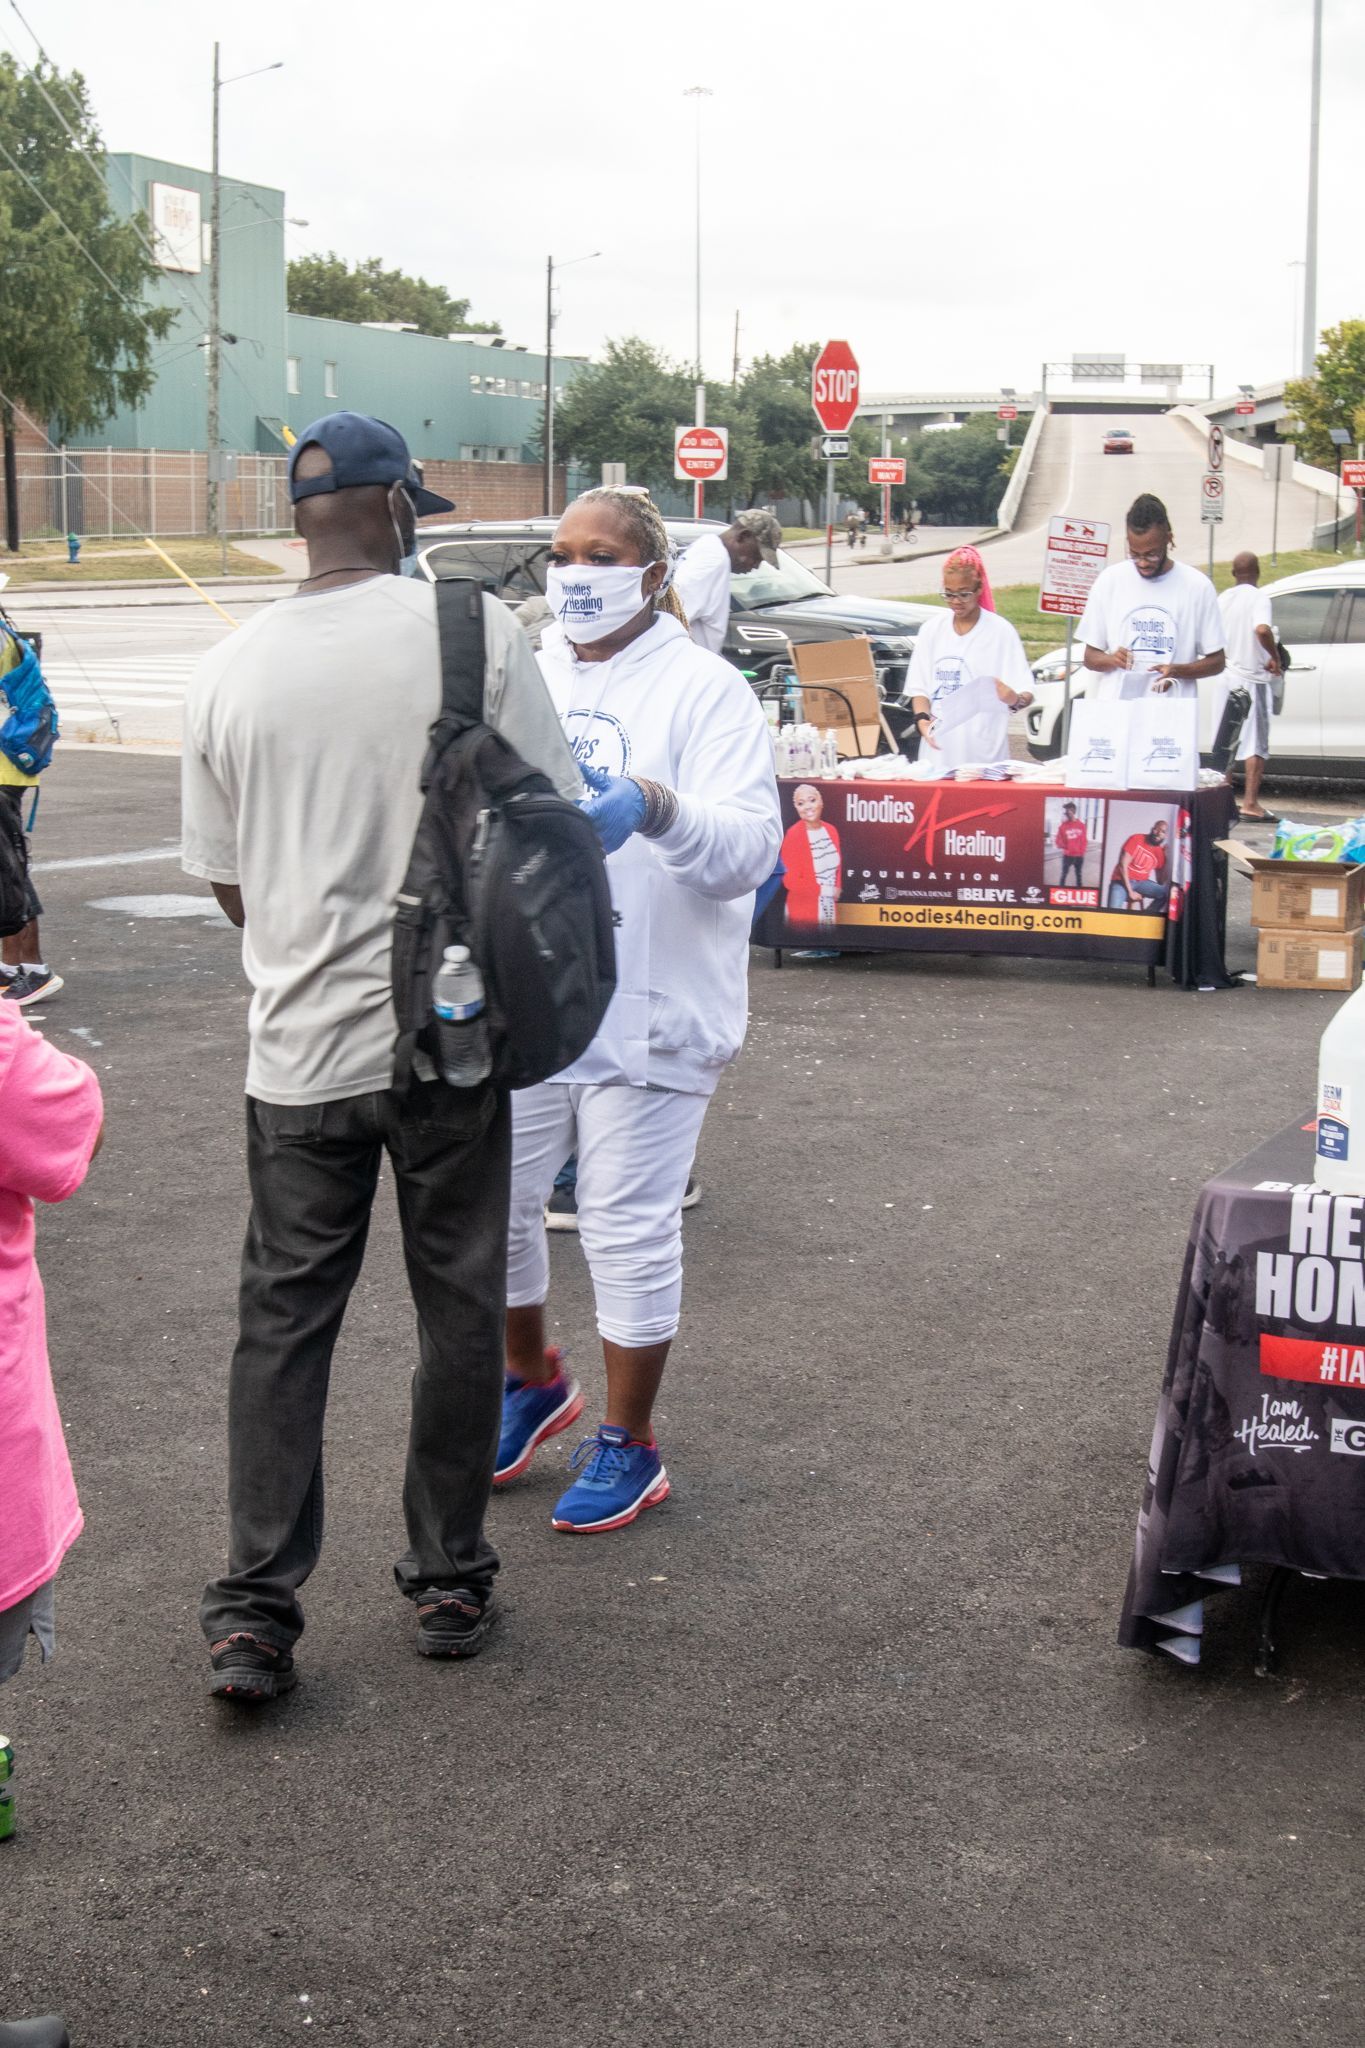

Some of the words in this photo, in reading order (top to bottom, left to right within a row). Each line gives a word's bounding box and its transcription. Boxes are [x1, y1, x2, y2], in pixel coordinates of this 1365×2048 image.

[815, 368, 858, 403] STOP
[683, 437, 698, 447] DO
[700, 438, 720, 448] NOT
[686, 460, 716, 470] ENTER
[876, 471, 898, 481] WAY
[561, 582, 592, 597] Hoodies
[569, 595, 603, 612] Healing
[846, 793, 915, 824] Hoodies
[944, 829, 1006, 862] Healing
[846, 869, 1000, 881] FOUNDATION
[1053, 890, 1098, 905] GLUE
[879, 907, 1082, 930] hoodies4healing.com
